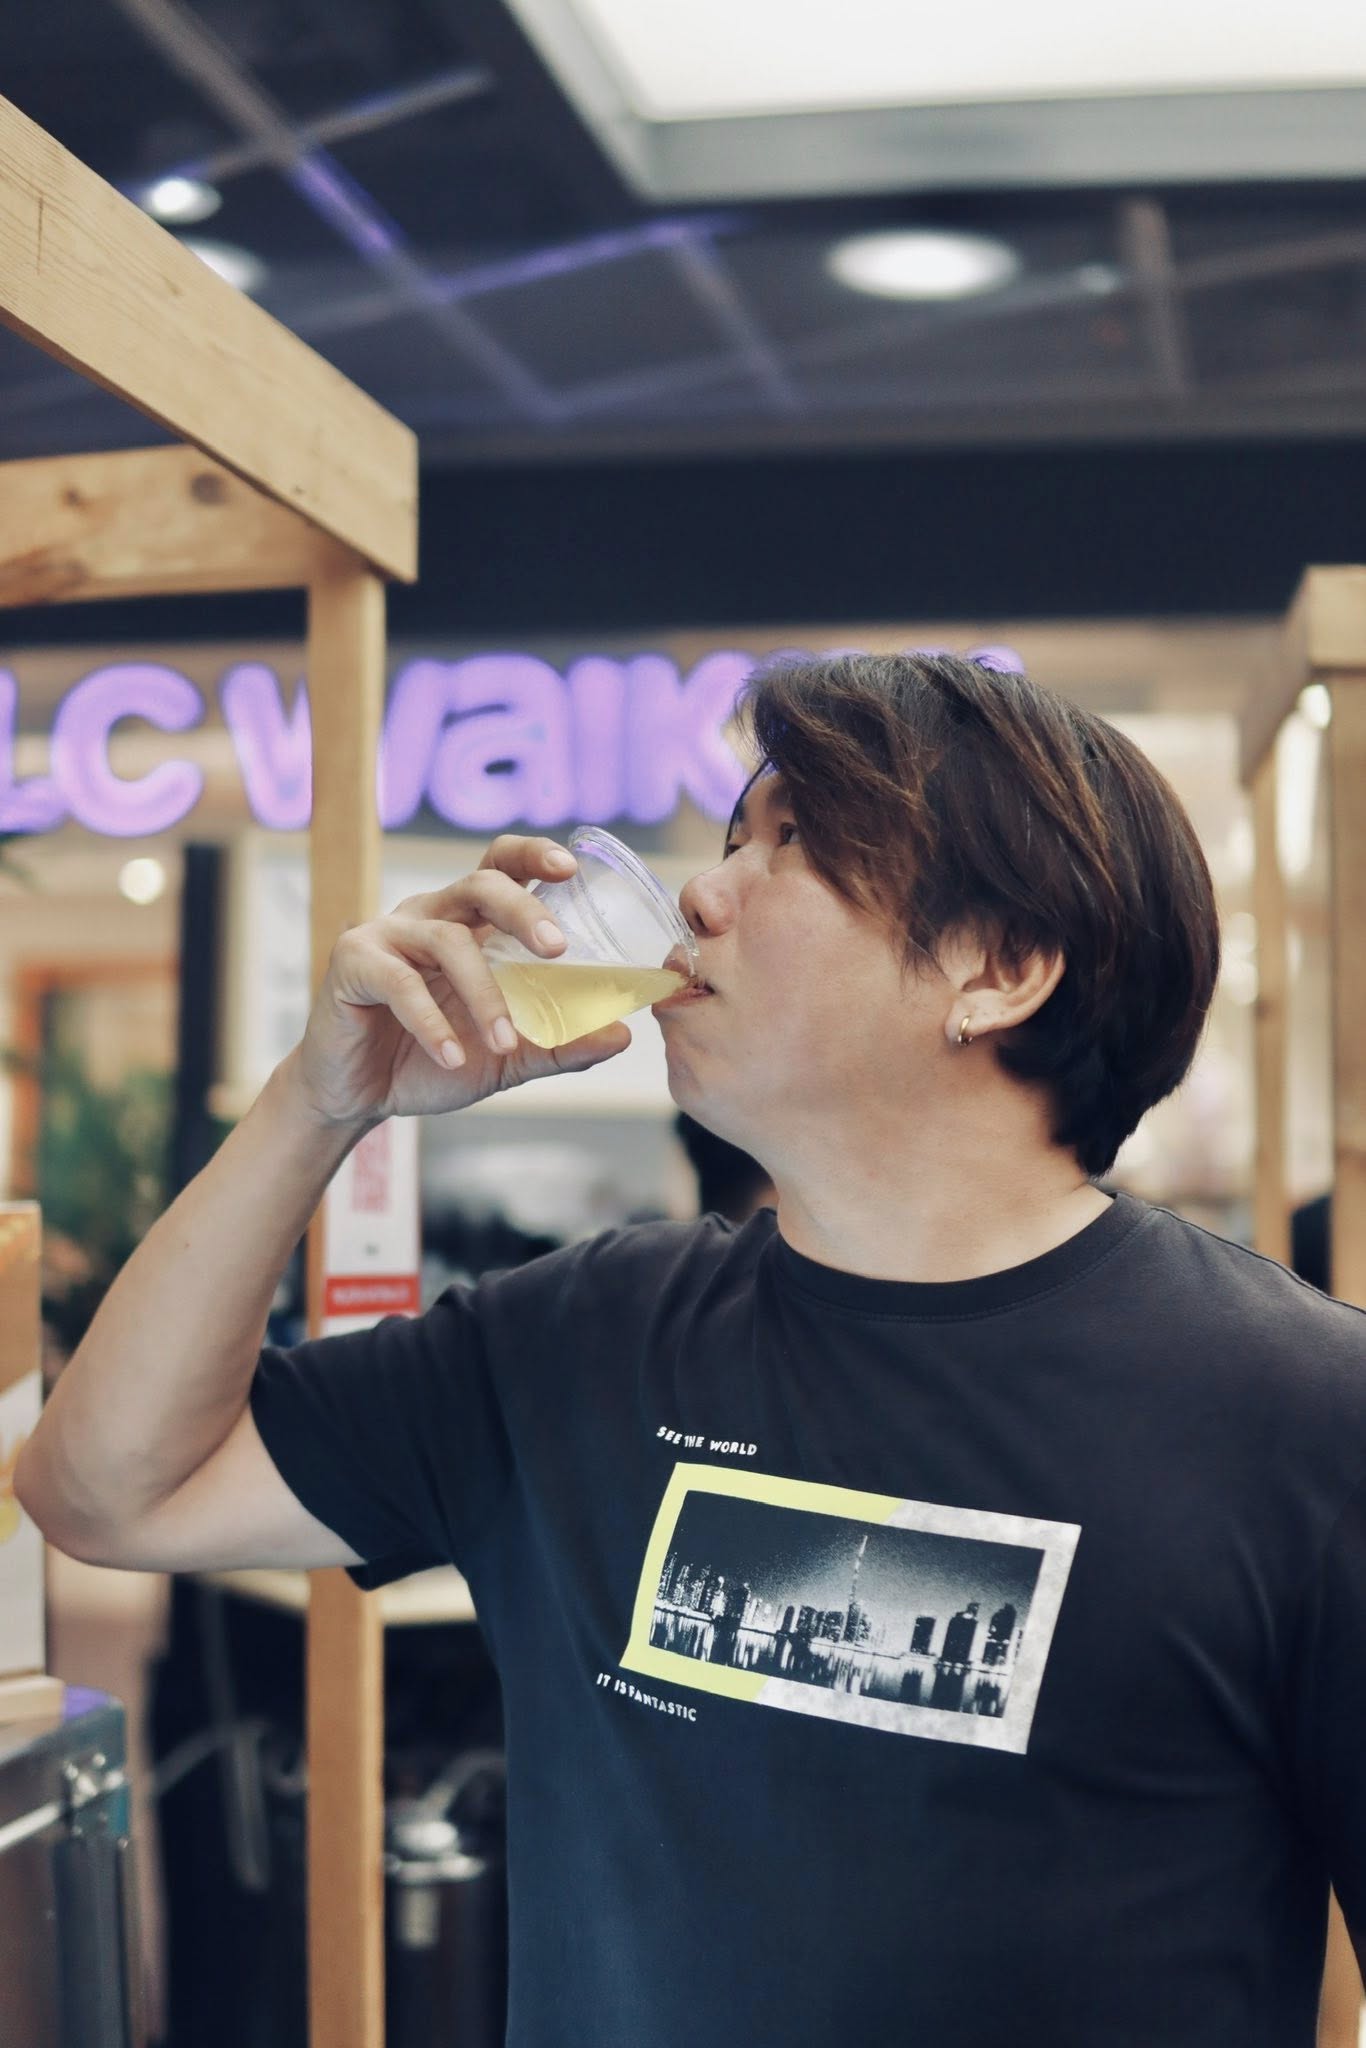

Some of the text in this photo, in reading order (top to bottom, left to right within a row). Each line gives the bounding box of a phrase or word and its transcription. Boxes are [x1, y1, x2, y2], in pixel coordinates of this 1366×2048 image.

[656, 1425, 758, 1456] SEE THE WORLD
[596, 1672, 697, 1722] IT IS FANTASTIC
